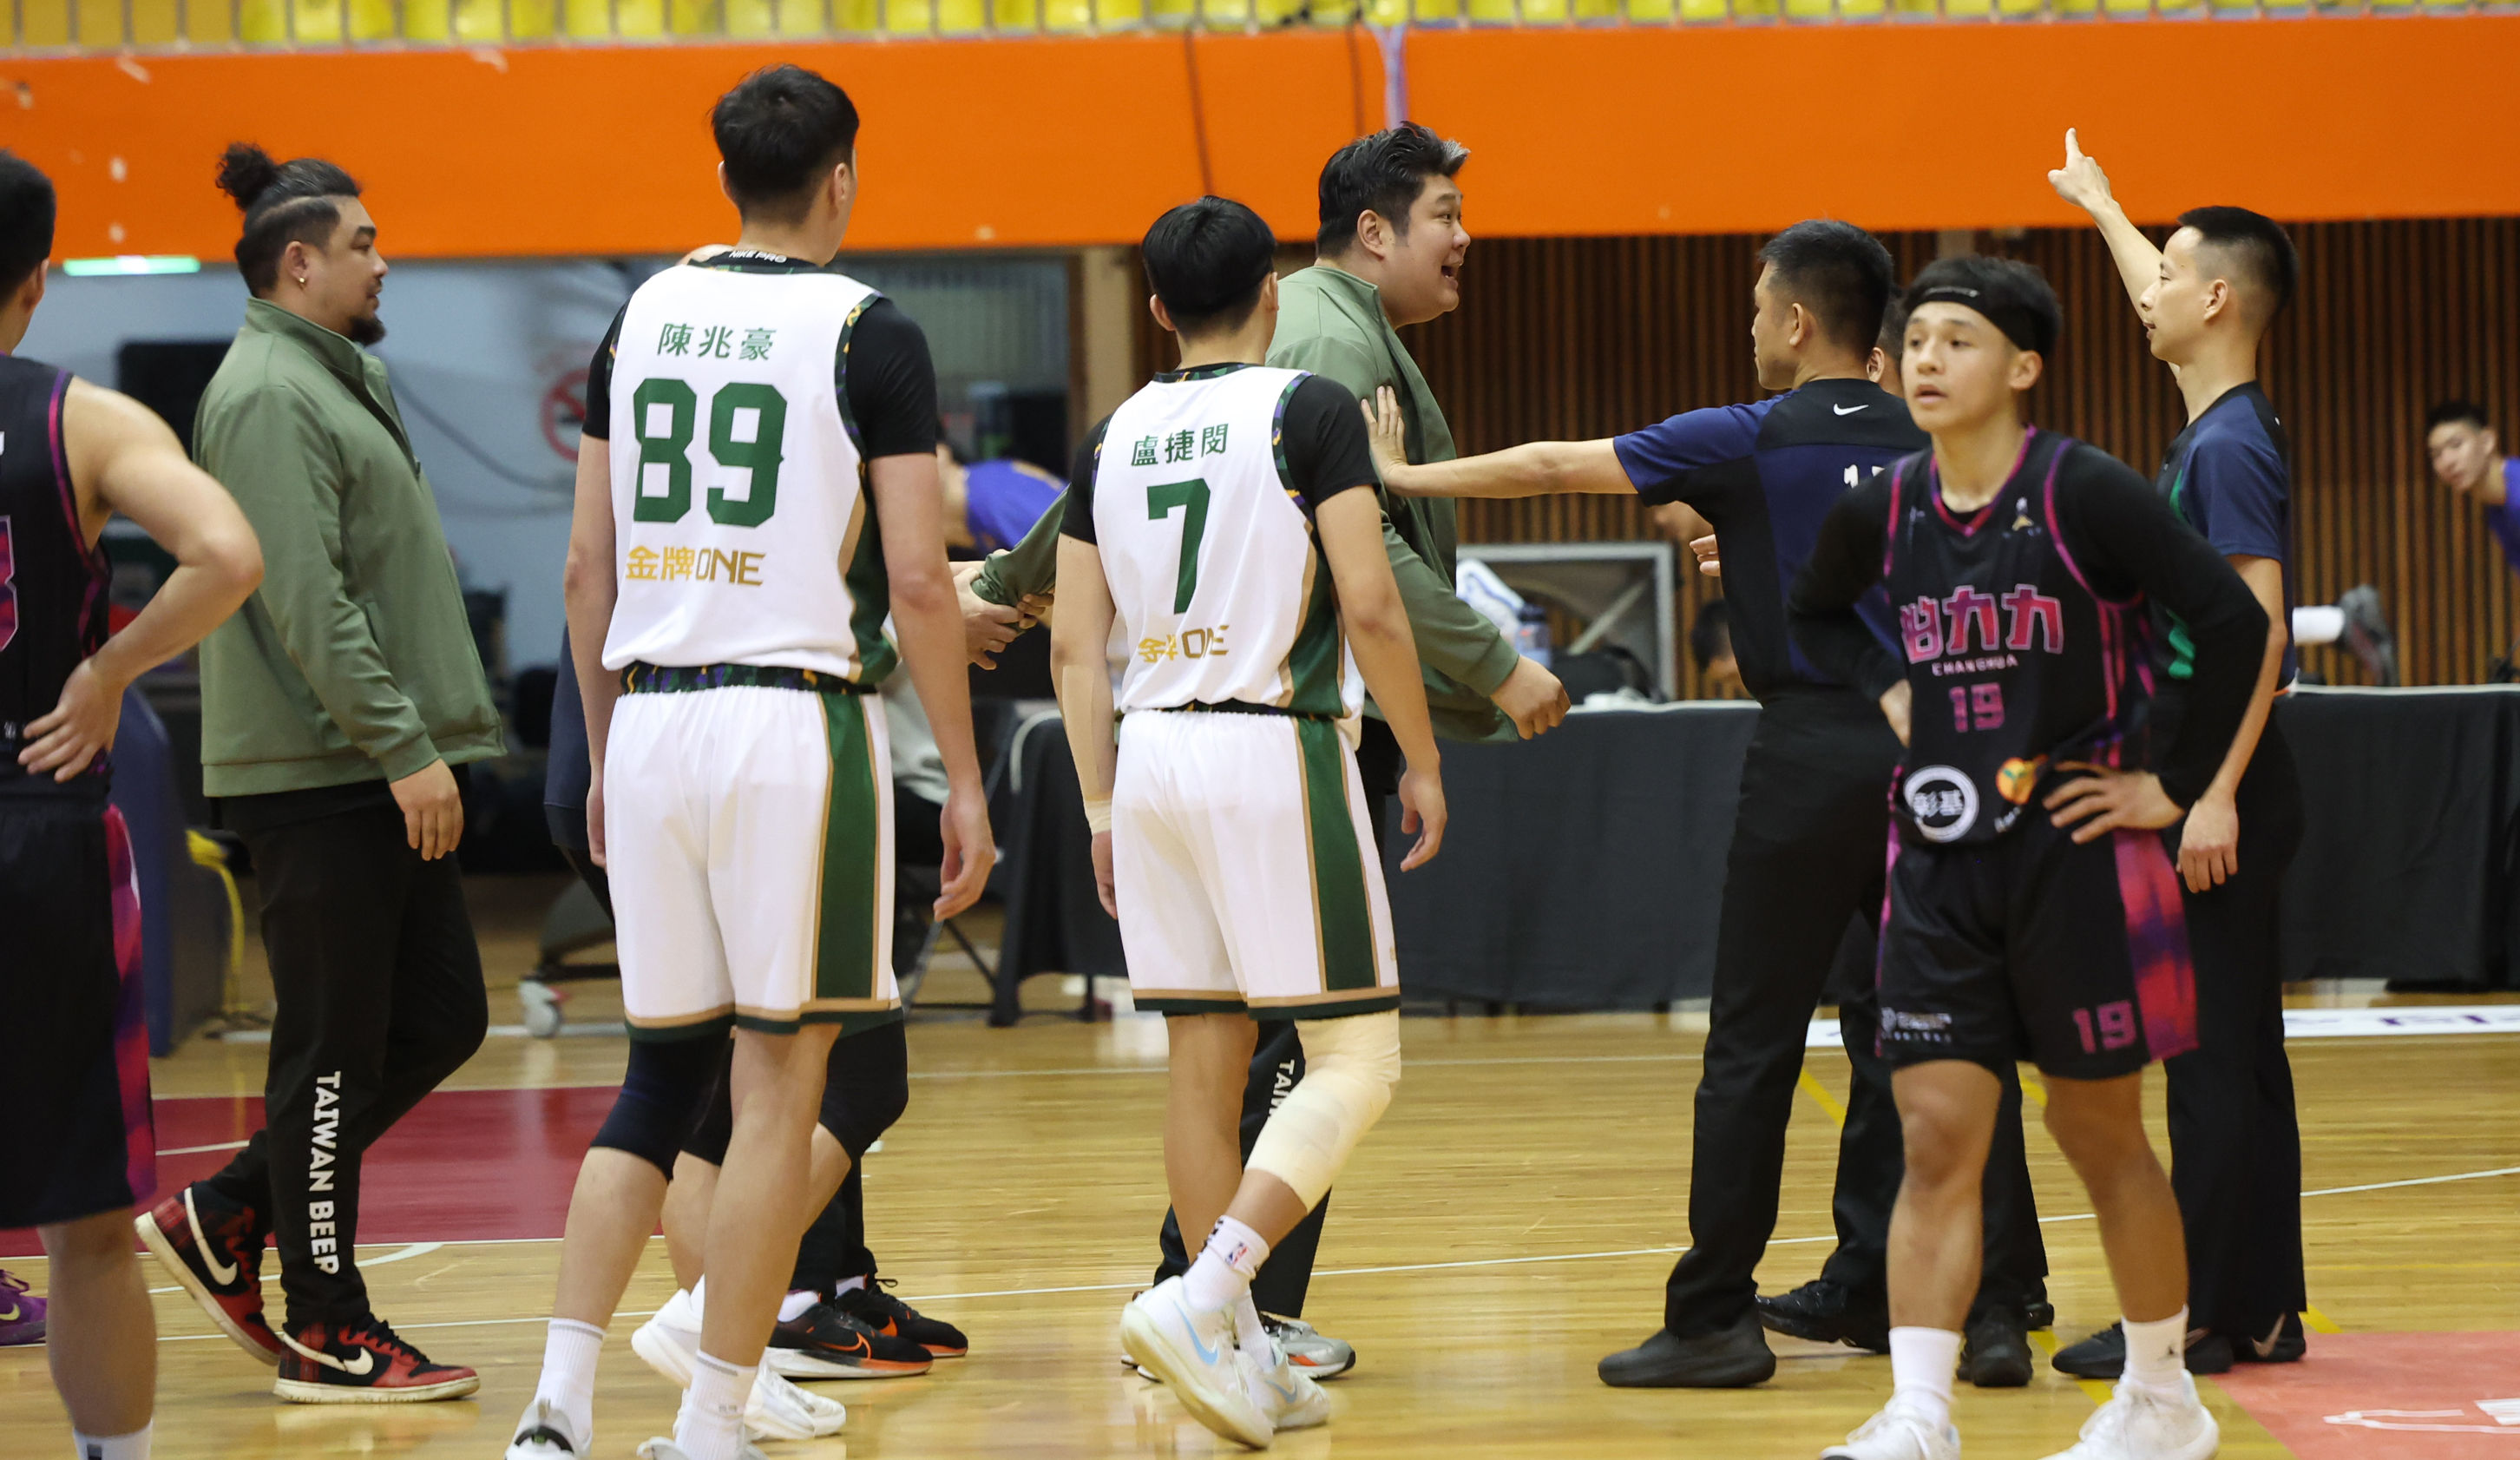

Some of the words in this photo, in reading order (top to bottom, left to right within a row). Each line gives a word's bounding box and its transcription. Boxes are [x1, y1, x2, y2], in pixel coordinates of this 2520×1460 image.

[729, 249, 758, 258] NIKE
[755, 251, 787, 263] PRO
[657, 323, 778, 361] 陳兆豪
[633, 378, 788, 529] 89
[1131, 423, 1229, 466] 盧捷閔
[625, 544, 766, 587] 金牌ONE
[1146, 477, 1211, 615] 7
[1949, 682, 2005, 733] 19
[2073, 999, 2136, 1054] 19
[309, 1070, 342, 1192] TAIWAN
